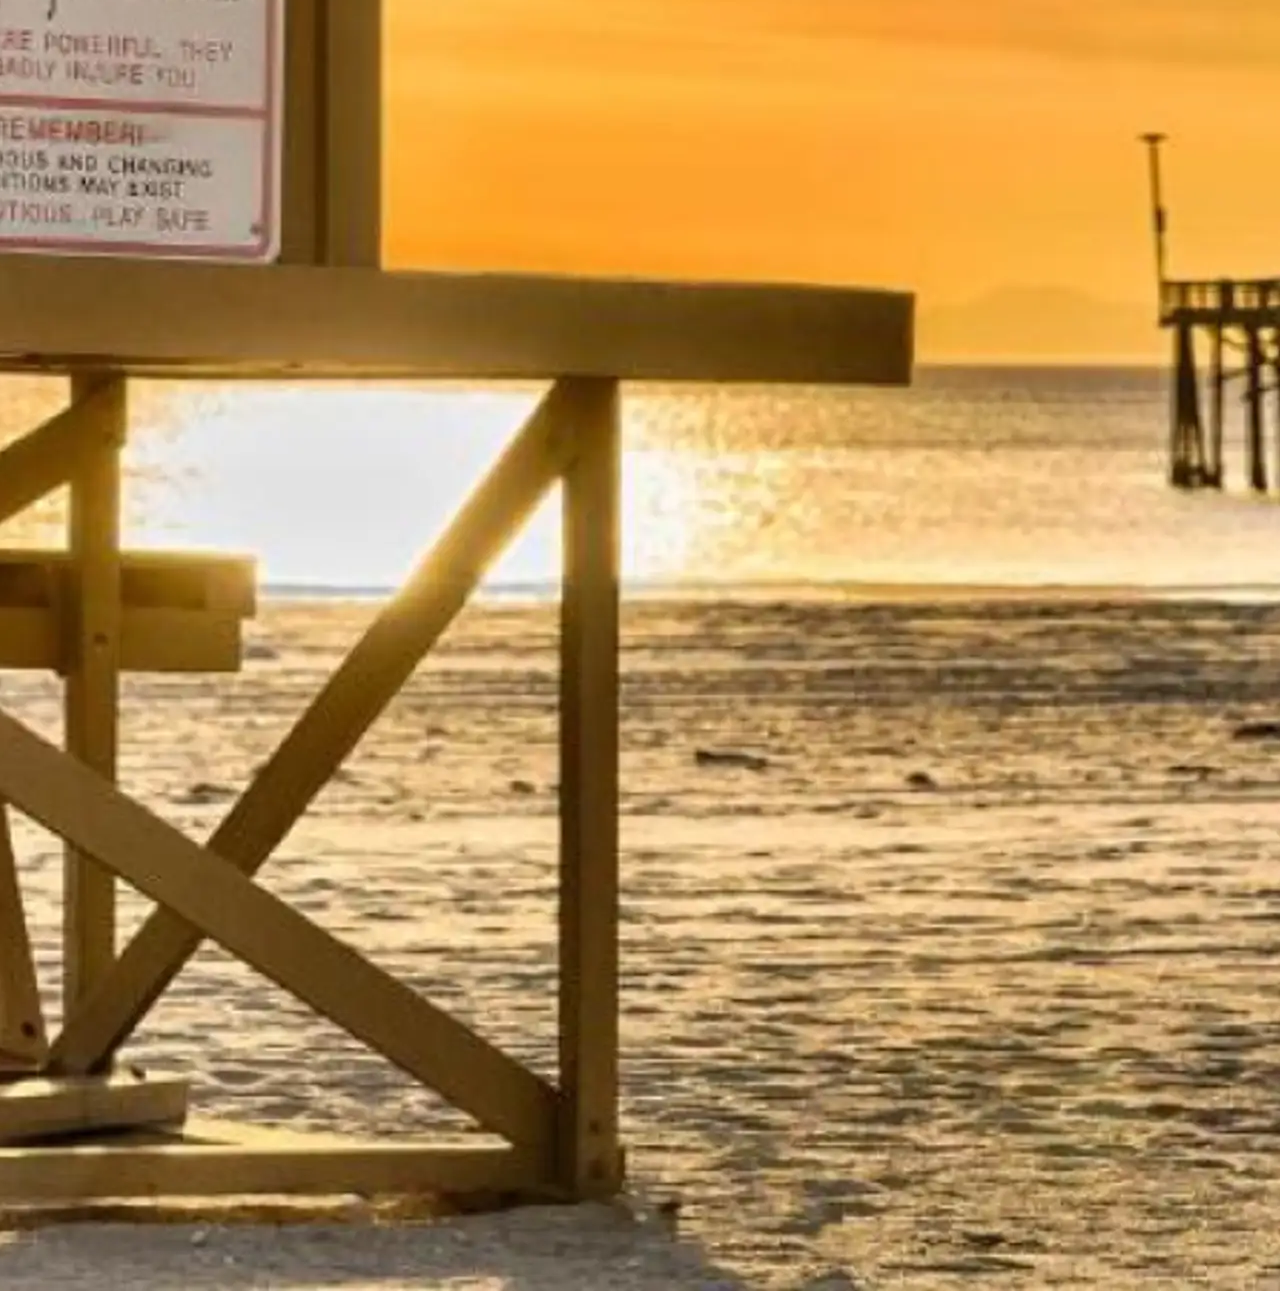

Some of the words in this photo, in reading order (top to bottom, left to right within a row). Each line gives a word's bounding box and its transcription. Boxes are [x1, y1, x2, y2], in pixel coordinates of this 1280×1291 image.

[179, 38, 234, 62] THEY
[57, 153, 98, 171] AND
[108, 154, 213, 178] CHANGING
[80, 176, 121, 195] MAY
[128, 180, 185, 199] EXIST
